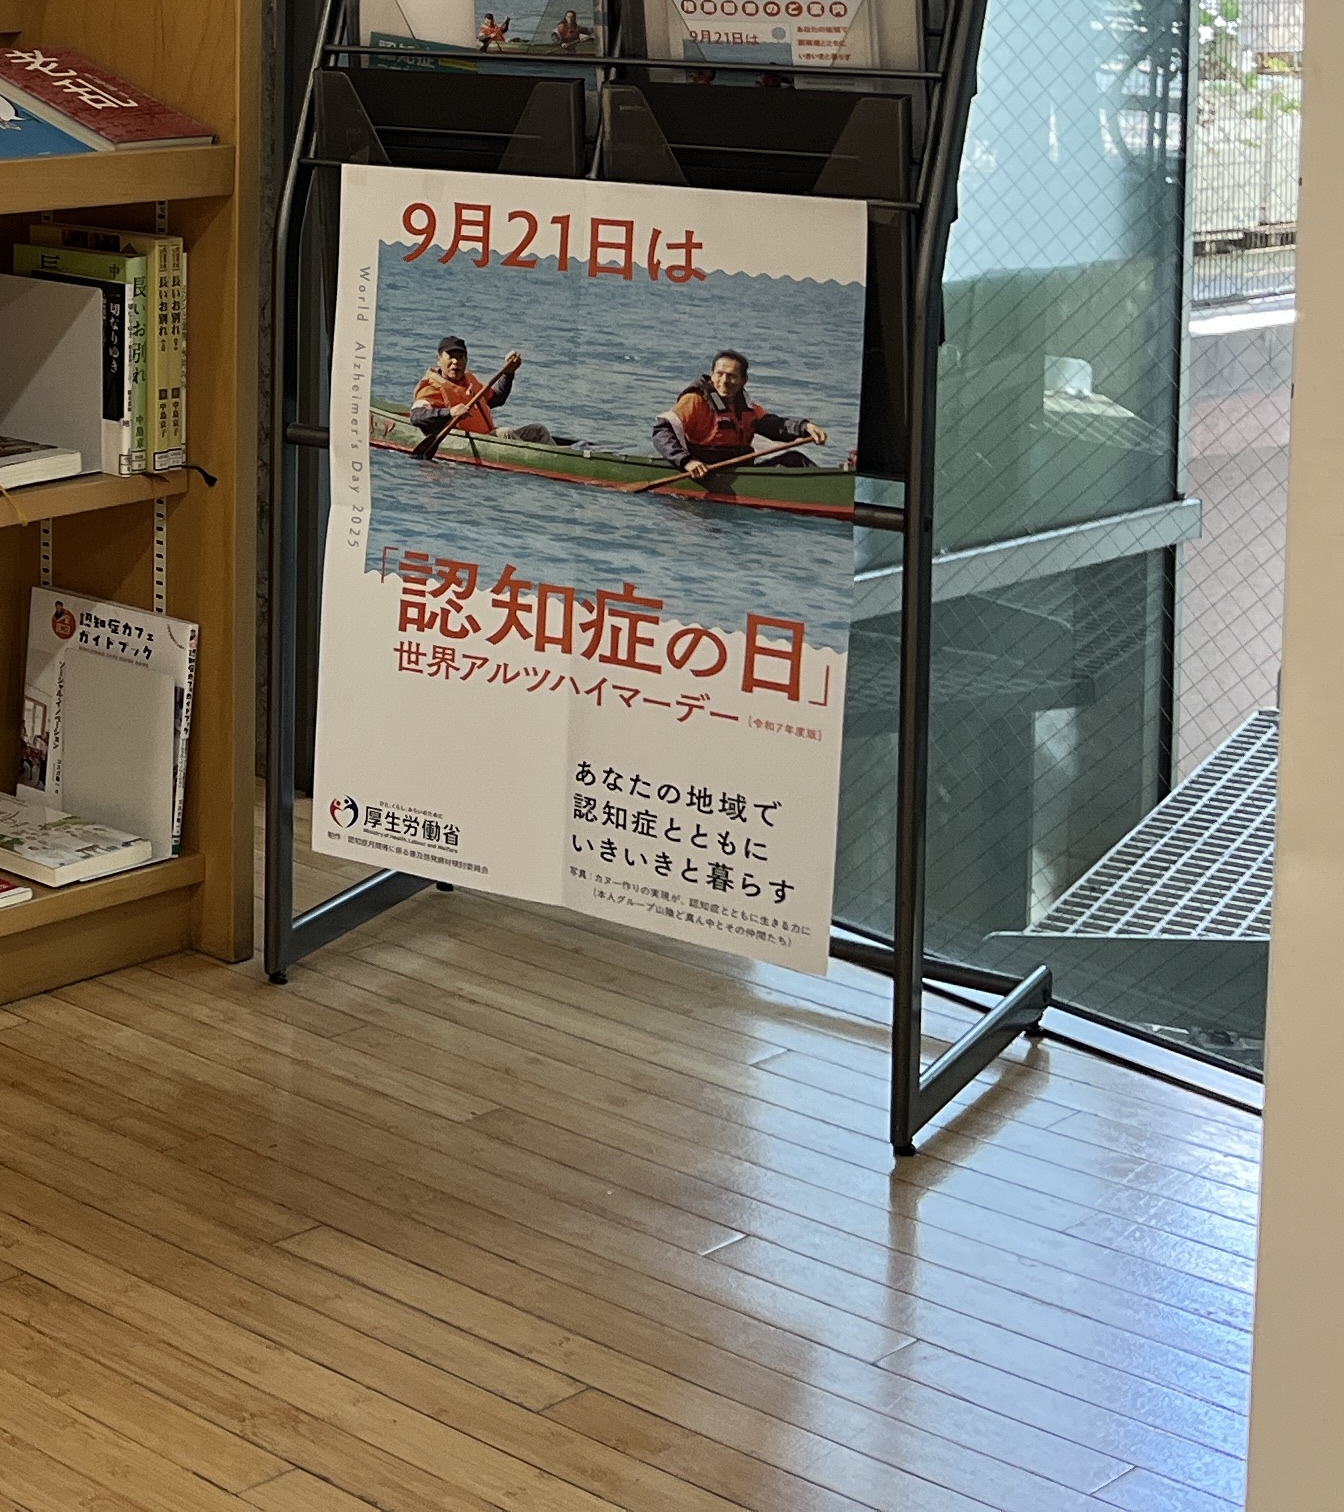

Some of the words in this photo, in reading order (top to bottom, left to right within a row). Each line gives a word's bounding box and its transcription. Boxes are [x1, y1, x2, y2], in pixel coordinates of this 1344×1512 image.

[689, 30, 760, 46] 9月21日は
[5, 49, 139, 110] 老乱
[402, 202, 706, 282] 9月21日は
[158, 276, 168, 337] 長いお別れ
[172, 275, 180, 336] 長いお別れ
[355, 266, 371, 322] World
[109, 292, 120, 374] 一切なりゆき
[132, 277, 146, 384] 長いお別れ
[351, 342, 366, 453] Alzheimer's
[350, 460, 363, 496] Day
[347, 505, 364, 548] 2025
[79, 612, 154, 642] 認知症カフェ
[79, 630, 152, 660] ガイドブック
[381, 546, 831, 706] 「認知症の日」
[393, 642, 739, 724] 世界アルツハイマーデー
[575, 761, 782, 827] あなたの地域で
[363, 805, 460, 847] 厚生労働省
[573, 794, 768, 862] 認知症とともに
[571, 834, 795, 904] いきいきと暮らす
